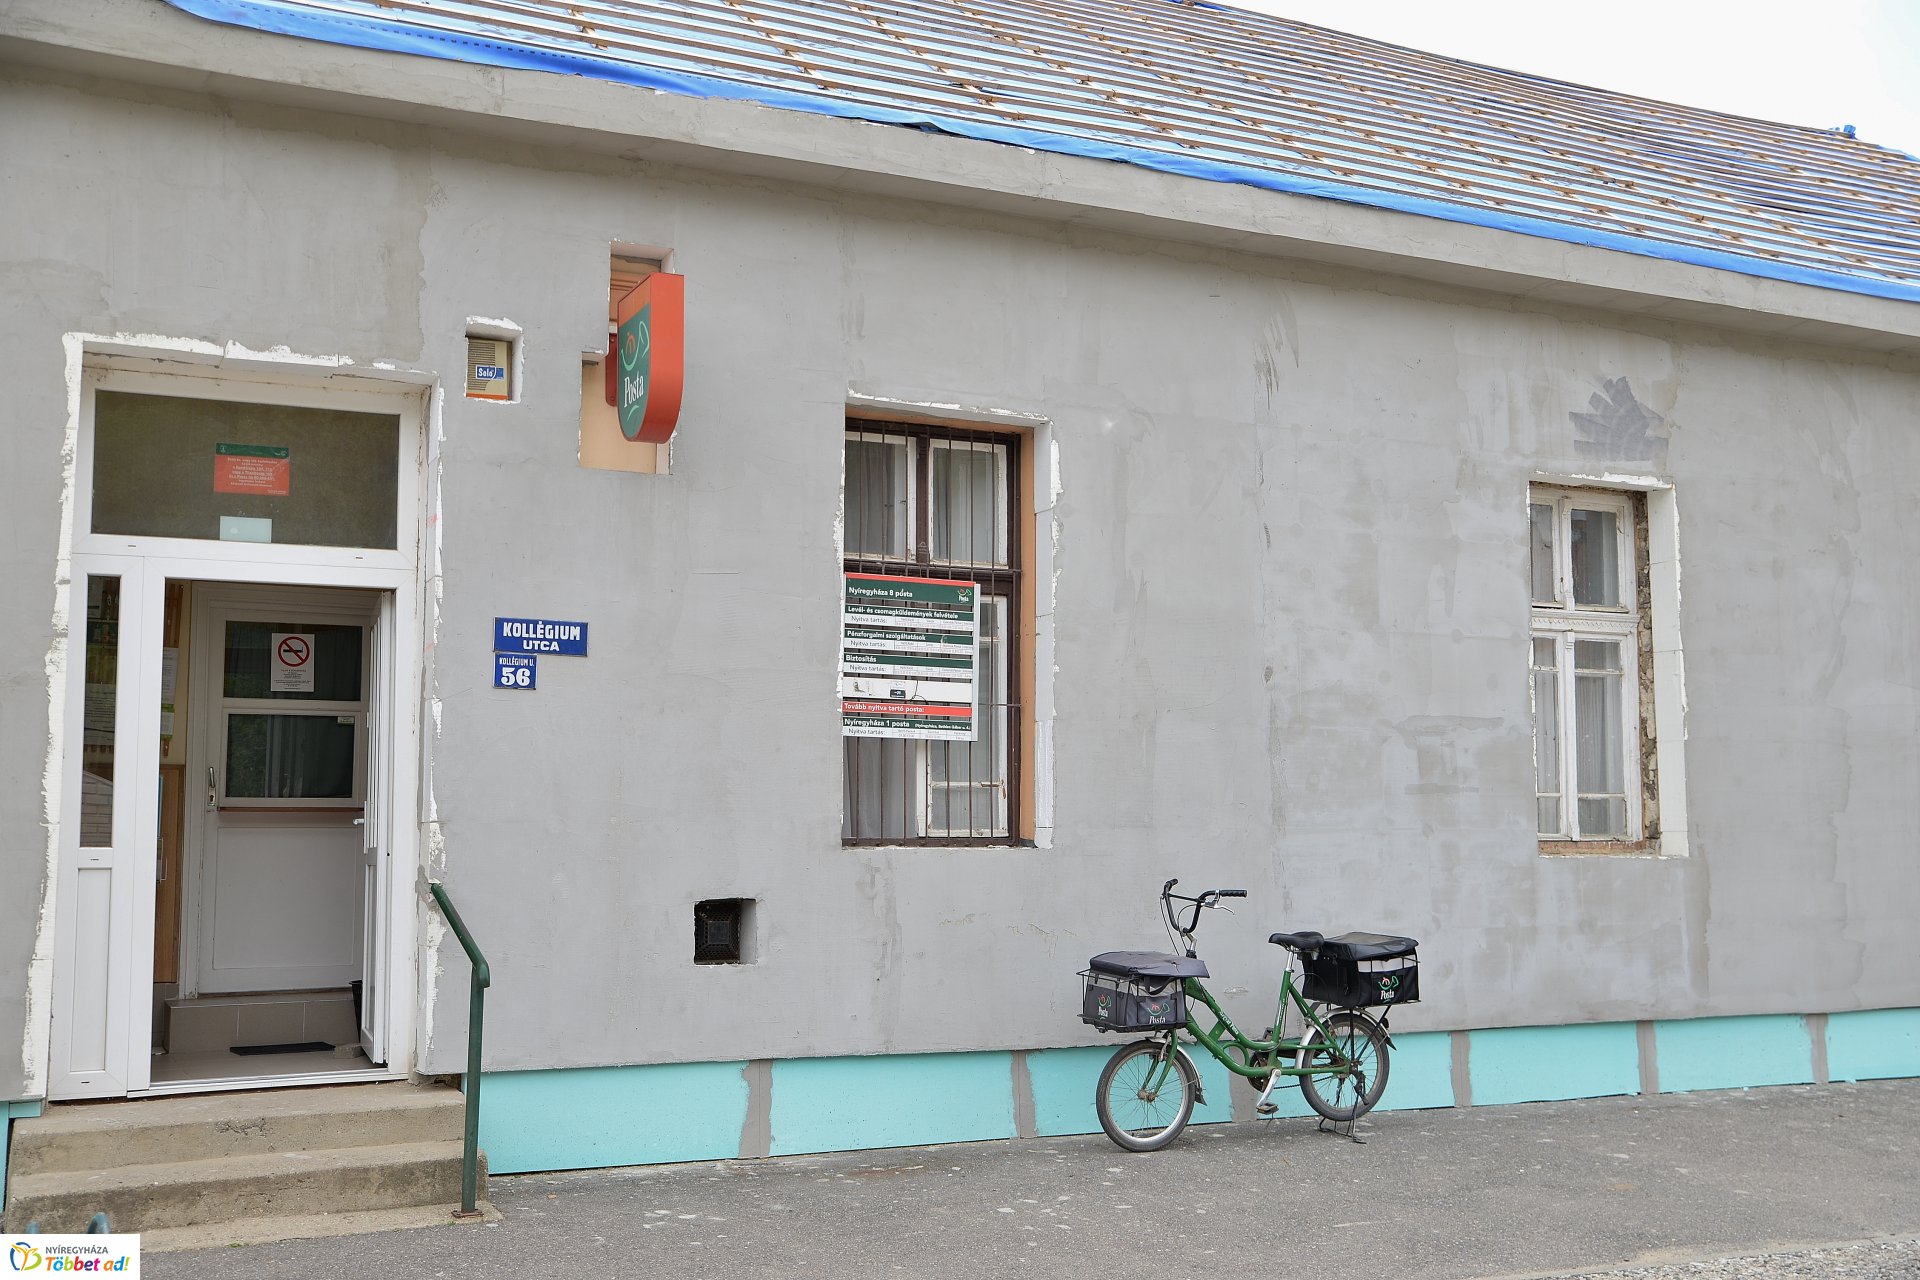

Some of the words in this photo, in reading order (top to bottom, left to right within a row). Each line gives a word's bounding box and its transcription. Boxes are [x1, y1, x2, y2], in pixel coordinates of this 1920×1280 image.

[623, 371, 644, 408] Posta
[848, 586, 888, 597] Nyíregyháza
[874, 608, 933, 618] csomagküldemények
[851, 615, 870, 624] Nyitva
[870, 616, 888, 624] tartás:
[503, 621, 581, 641] KOLLÉGIUM
[847, 630, 885, 639] Pénzforgalmi
[885, 633, 926, 641] szolgáltatások
[523, 640, 560, 651] UTCA
[850, 640, 869, 648] Nyitva
[499, 656, 528, 666] KOLLÉGIUM
[529, 659, 535, 667] U.
[845, 654, 877, 663] Biztosítás
[849, 664, 868, 672] Nyitva
[501, 667, 531, 687] 56
[844, 702, 867, 710] Tovább
[867, 704, 887, 712] nyitva
[905, 706, 925, 714] posta:
[844, 718, 885, 728] Nyíregyháza
[891, 721, 910, 729] posta
[848, 728, 867, 736] Nyitva
[867, 728, 886, 736] tartás:
[1380, 989, 1395, 1000] Posta
[1149, 1015, 1166, 1024] Posta
